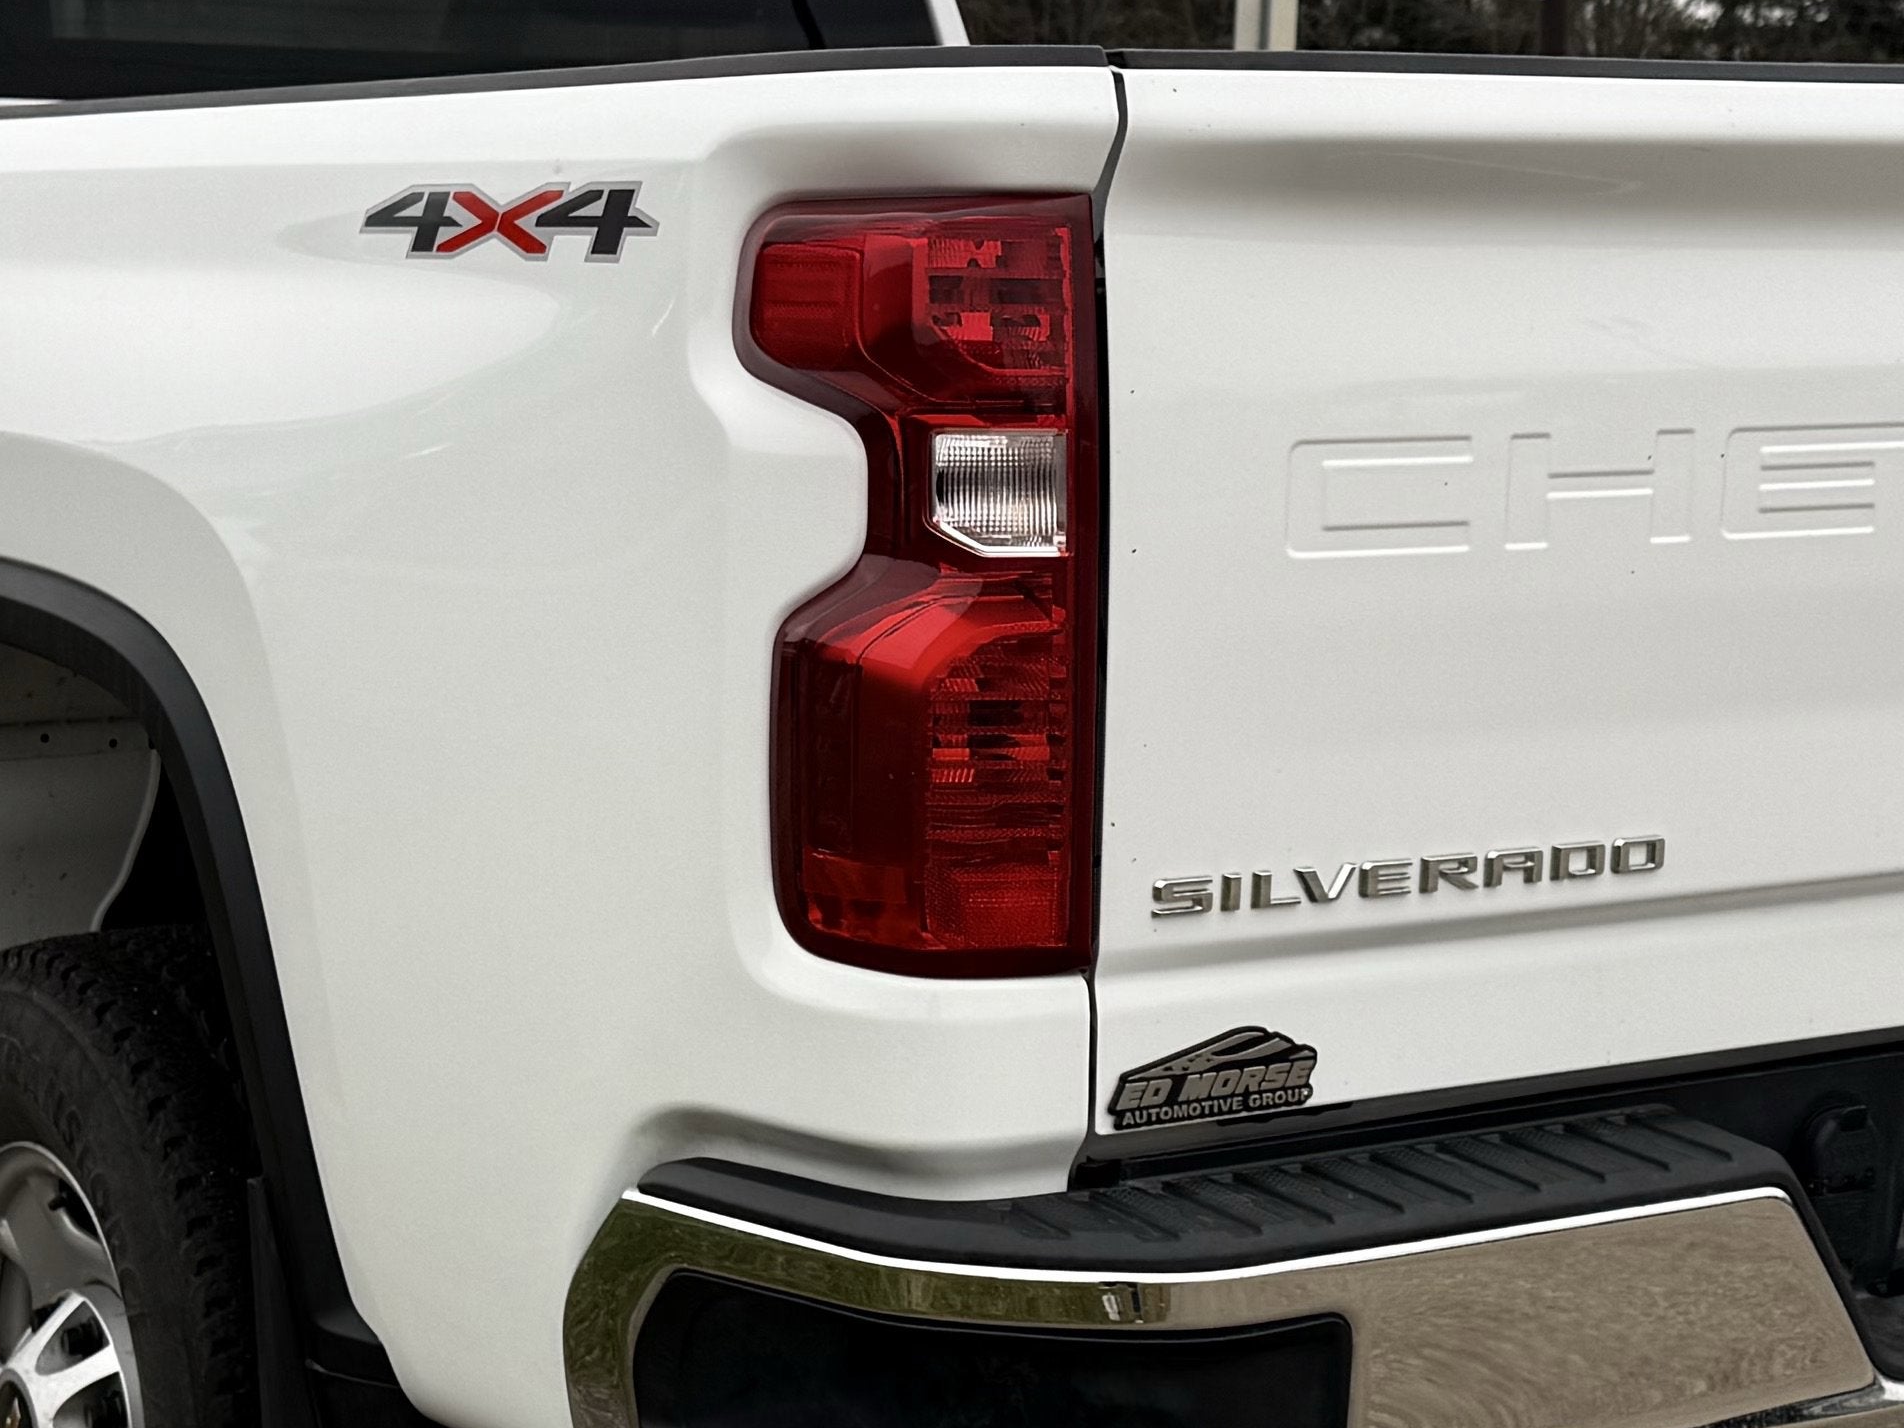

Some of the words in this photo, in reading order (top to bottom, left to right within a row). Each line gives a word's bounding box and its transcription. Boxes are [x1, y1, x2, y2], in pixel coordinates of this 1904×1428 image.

[1151, 834, 1667, 918] SILVERADO
[1116, 1079, 1173, 1111] ED
[1178, 1059, 1316, 1103] MORSE
[1122, 1096, 1244, 1126] AUTOMOTIVE
[1248, 1087, 1313, 1108] GROUP
